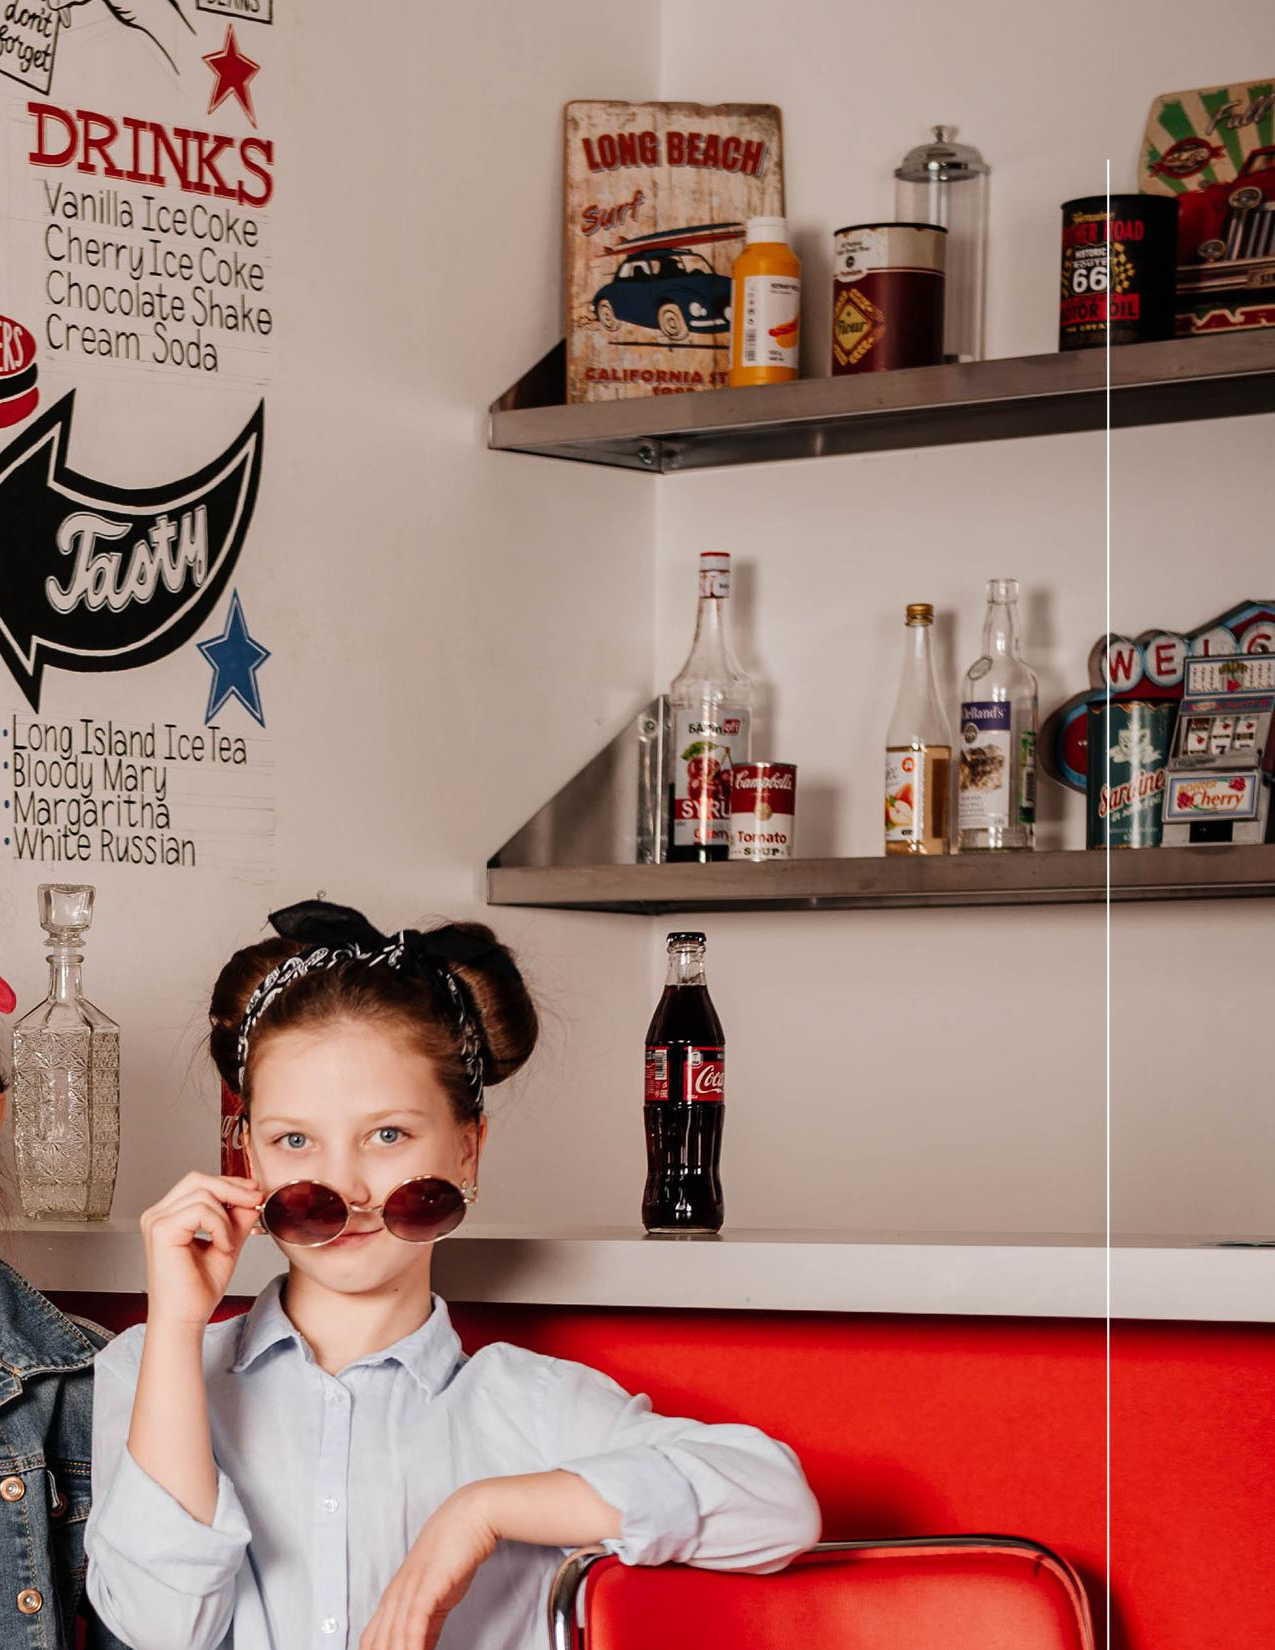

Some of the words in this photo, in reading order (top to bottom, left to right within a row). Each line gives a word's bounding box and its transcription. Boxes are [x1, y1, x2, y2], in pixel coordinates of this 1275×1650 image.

[4, 0, 53, 38] don't
[27, 101, 275, 209] DRINKS
[582, 131, 660, 174] LONG
[666, 131, 768, 178] BEACH
[42, 180, 135, 229] Vanilla
[190, 204, 260, 248] Coke
[581, 189, 644, 238] Surf
[45, 223, 144, 281] Cherry
[198, 246, 265, 292] Coke
[1072, 266, 1109, 293] 66
[45, 269, 186, 323] Chocolate
[191, 285, 273, 337] Shake
[46, 313, 141, 361] Cream
[152, 321, 219, 373] Soda
[584, 367, 704, 386] CALIFORNIA
[45, 503, 209, 615] Tasty
[12, 713, 73, 760] Long
[80, 719, 156, 758] Island
[165, 723, 205, 762] Ice
[207, 726, 248, 765] Tea
[13, 751, 93, 799] Bloody
[103, 757, 167, 802] Mary
[1191, 788, 1245, 812] Cherry
[13, 790, 171, 836] Margaritha
[13, 824, 92, 862] White
[100, 828, 196, 867] Russian
